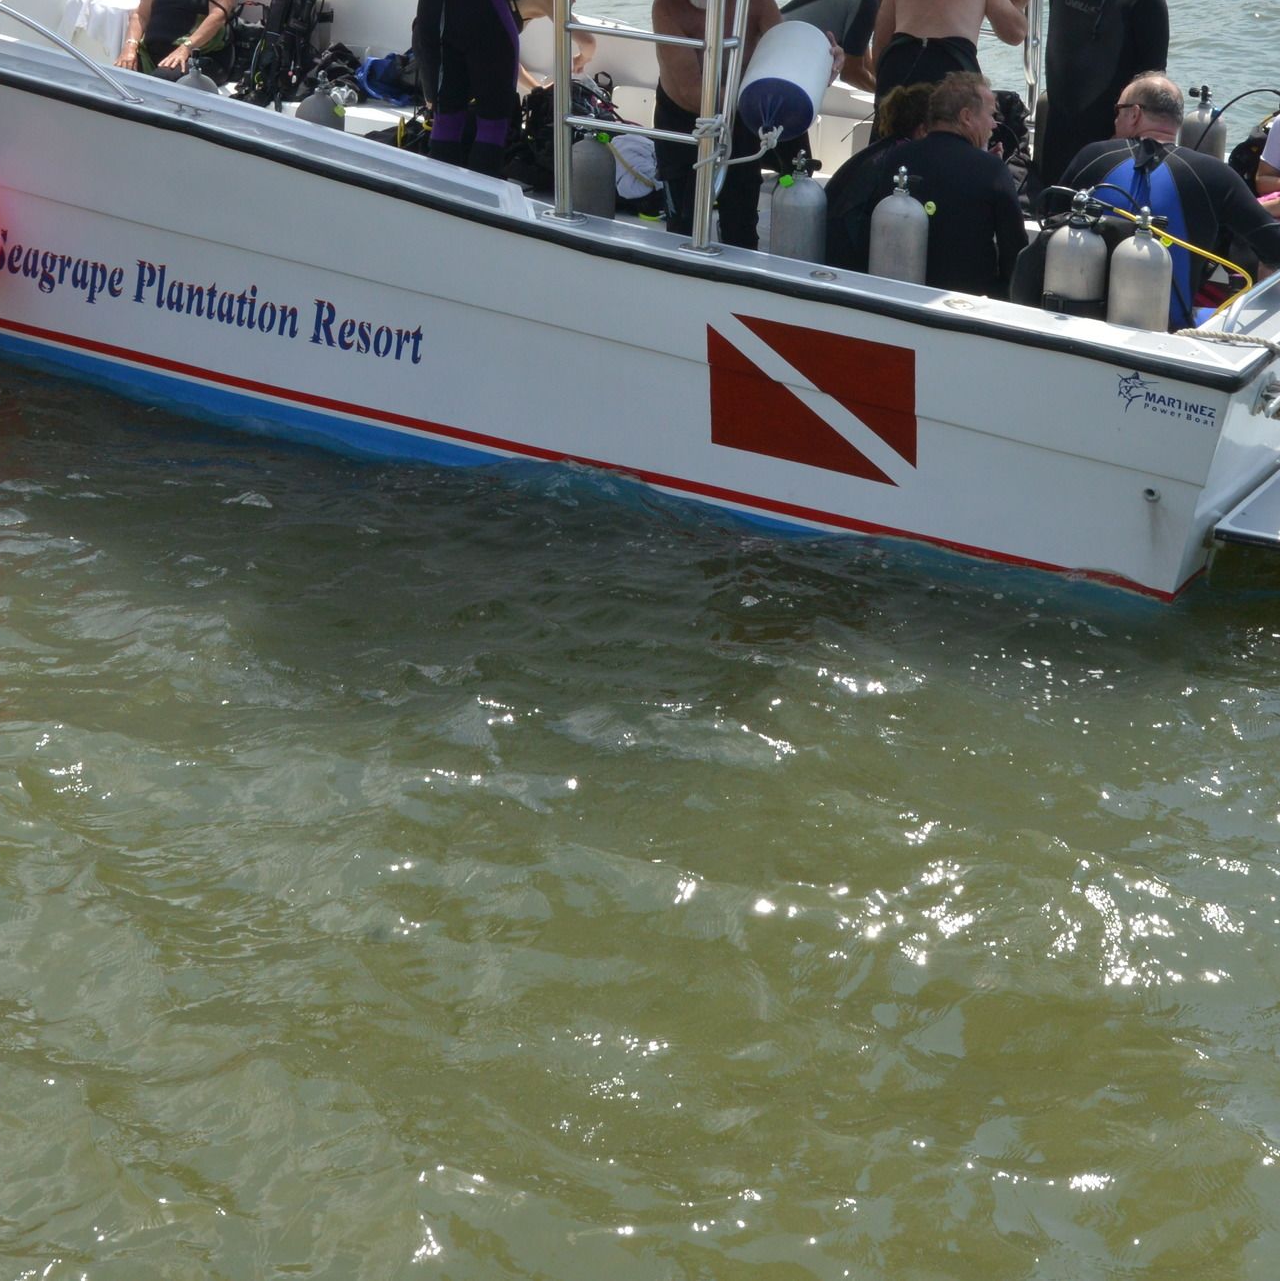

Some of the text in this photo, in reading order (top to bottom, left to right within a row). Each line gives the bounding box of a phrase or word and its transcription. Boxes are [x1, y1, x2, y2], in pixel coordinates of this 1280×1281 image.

[132, 259, 299, 338] Plantation
[308, 298, 424, 364] Resort
[1144, 391, 1217, 419] MARTINEZ
[1144, 402, 1215, 427] Power Boat
